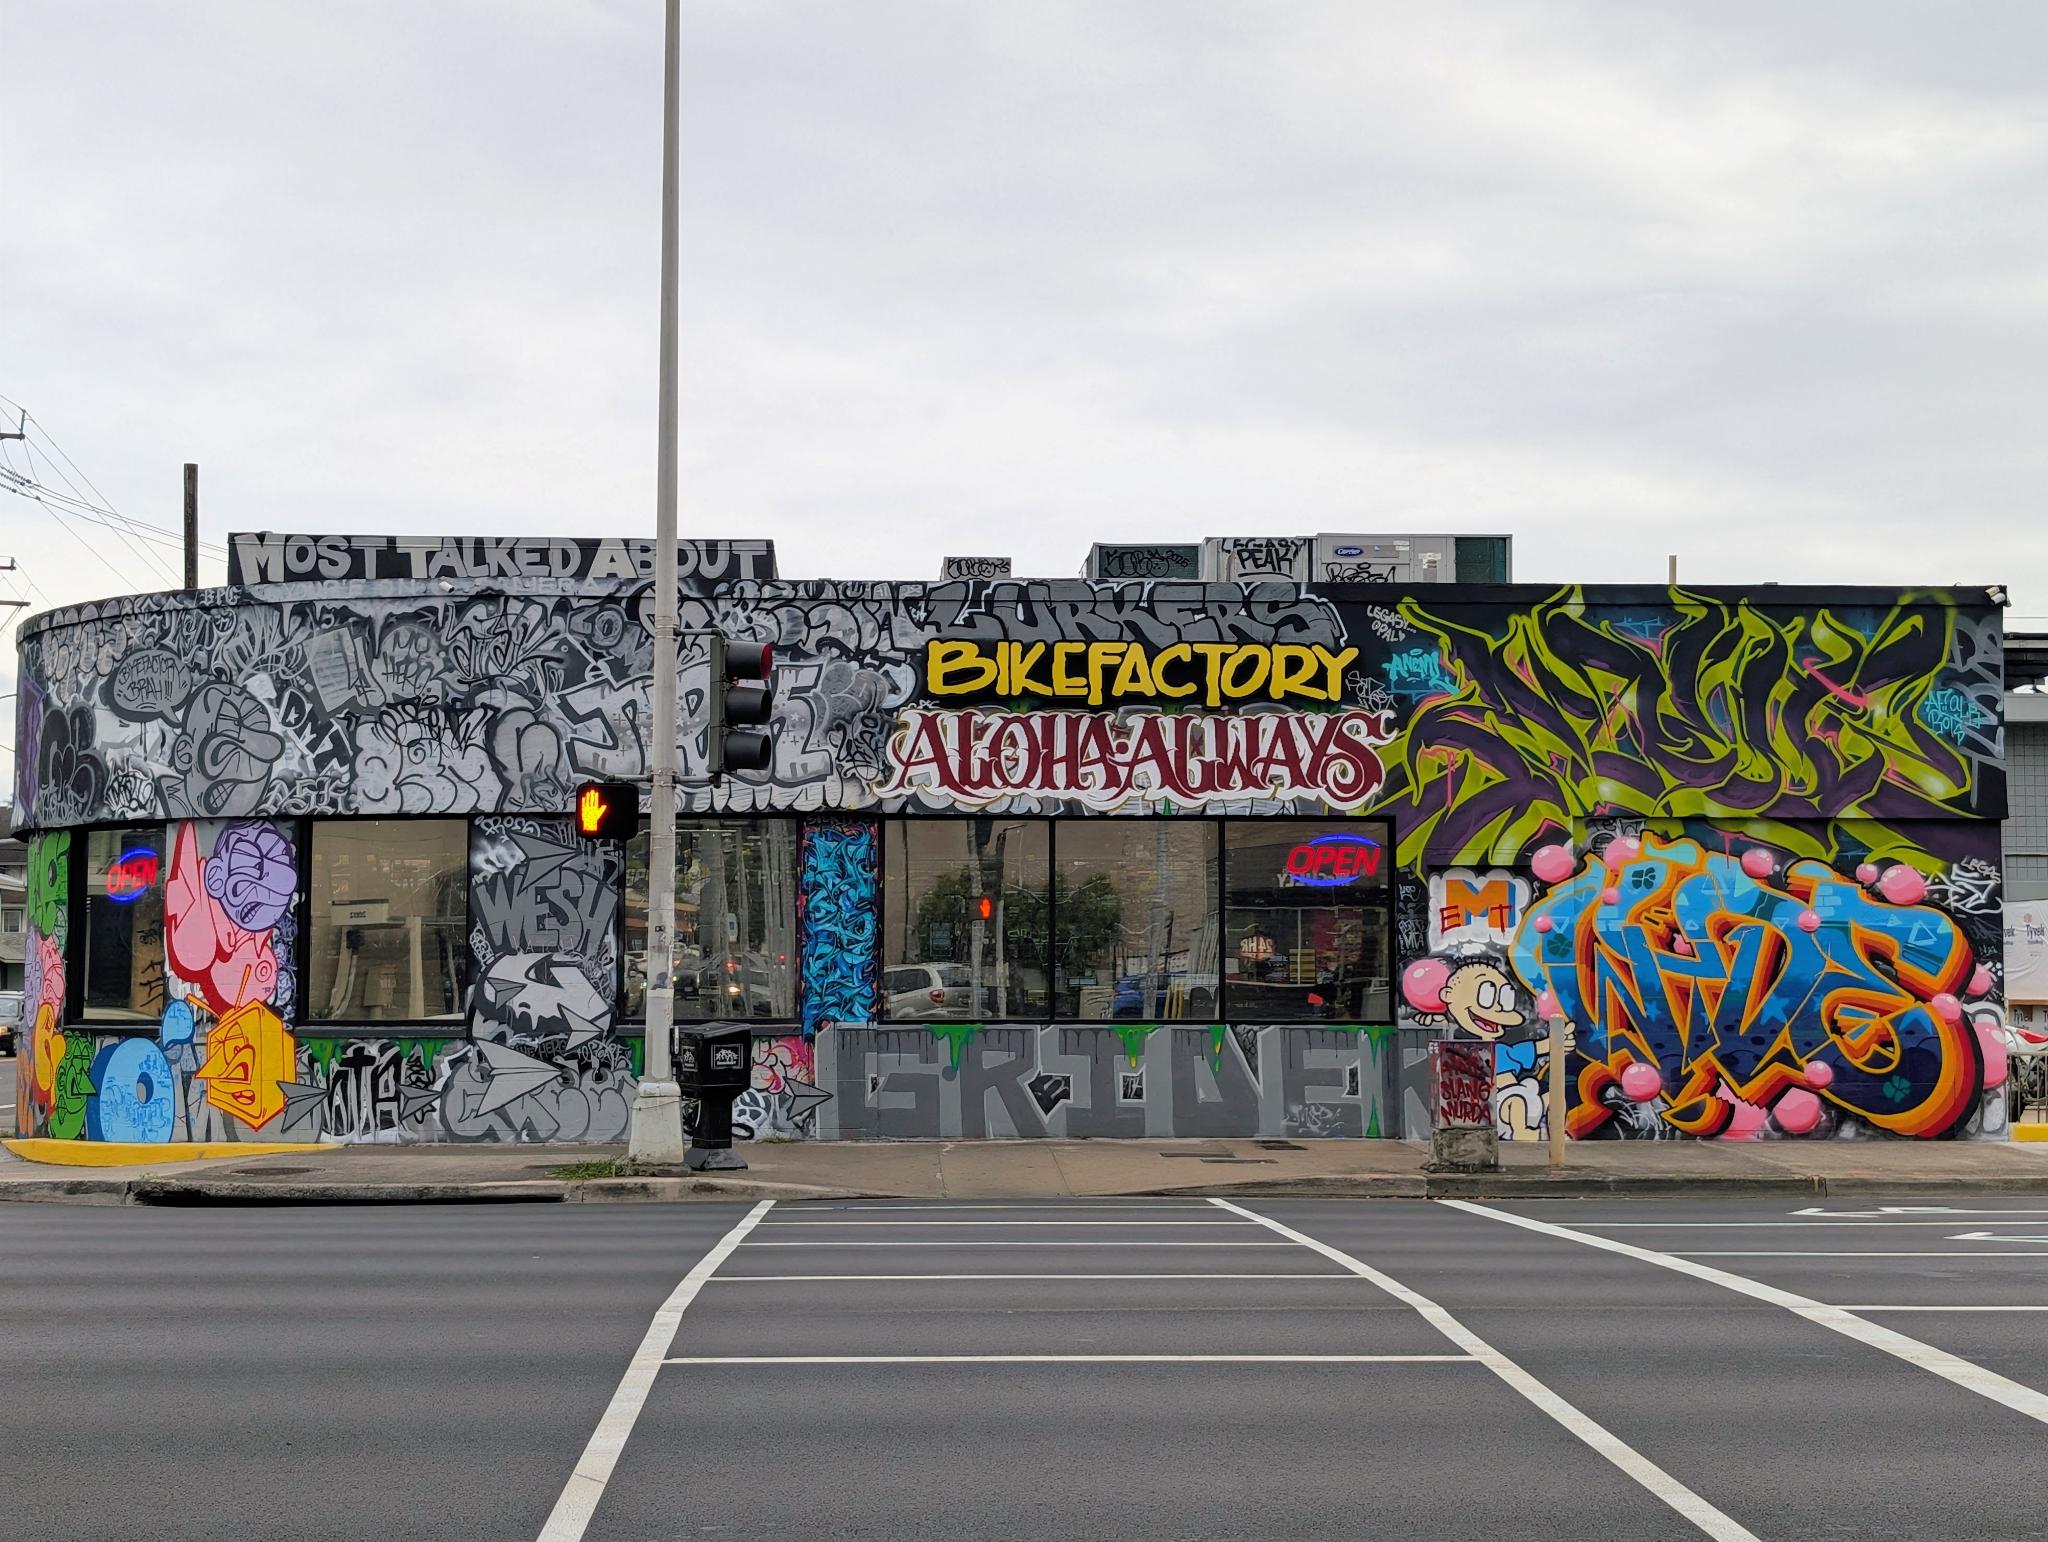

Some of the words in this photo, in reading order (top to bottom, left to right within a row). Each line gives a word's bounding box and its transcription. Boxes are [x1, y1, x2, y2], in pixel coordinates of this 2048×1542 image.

[234, 533, 388, 585] MOST
[396, 536, 581, 578] TALKED
[1236, 549, 1292, 574] PEAK
[928, 641, 1359, 707] BIKEFACTORY
[106, 856, 158, 893] OPEN
[1286, 845, 1380, 876] OPEN
